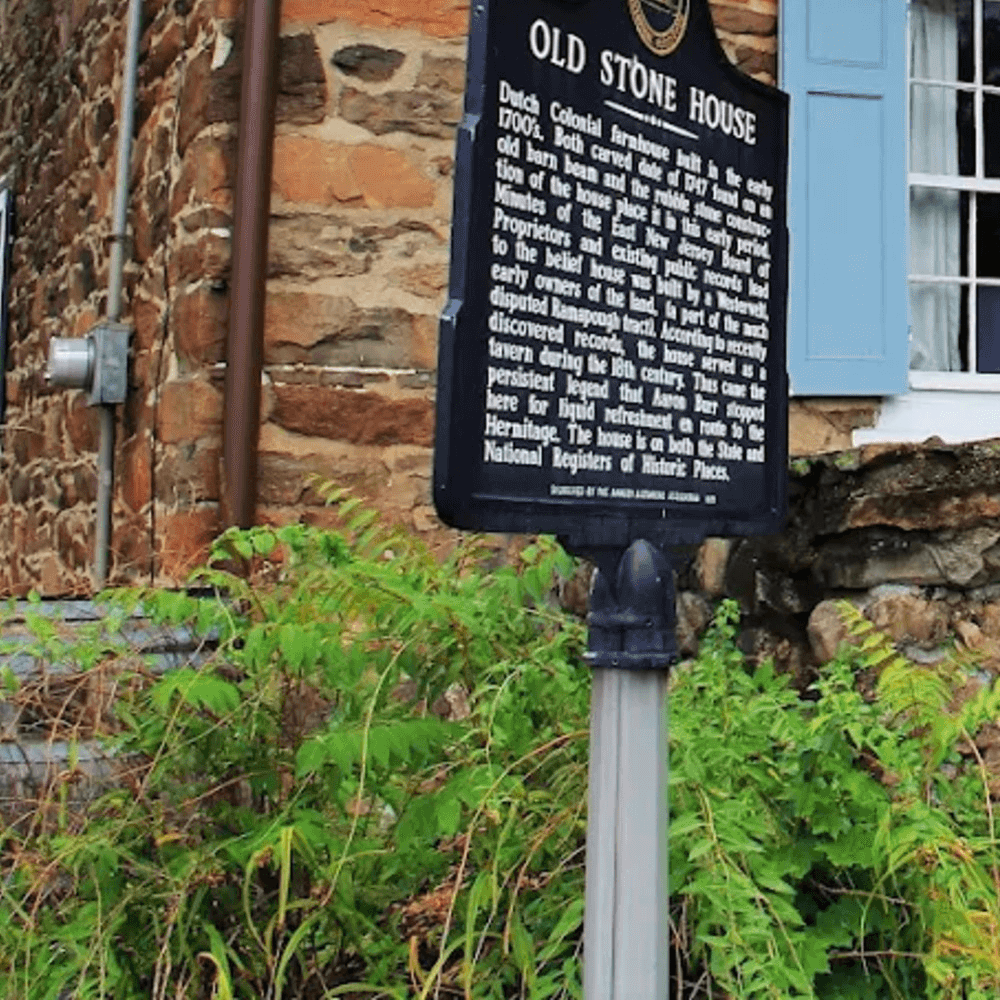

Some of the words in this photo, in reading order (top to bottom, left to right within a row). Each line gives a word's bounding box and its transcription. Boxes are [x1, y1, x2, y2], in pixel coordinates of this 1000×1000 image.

[529, 19, 586, 73] OLD
[600, 49, 678, 112] STONE
[689, 86, 757, 145] HOUSE
[496, 134, 520, 159] old
[525, 140, 558, 171] barn
[563, 153, 599, 185] beam
[602, 172, 626, 194] and
[630, 177, 651, 200] the
[653, 188, 690, 214] rubble
[693, 200, 723, 224] stone
[499, 80, 540, 116] Dutch
[549, 101, 602, 139] Colonial
[610, 123, 670, 163] farmhouse
[675, 148, 702, 174] built
[707, 159, 719, 180] in
[725, 166, 743, 189] the
[746, 178, 774, 202] early
[553, 124, 585, 155] Both
[590, 143, 633, 172] carved
[637, 156, 664, 182] date
[666, 168, 681, 188] of
[711, 182, 739, 209] found
[741, 198, 757, 214] on
[759, 203, 773, 220] an
[494, 181, 547, 216] Minutes
[556, 202, 573, 224] of
[581, 208, 602, 233] the
[611, 215, 637, 242] East
[645, 226, 670, 251] New
[677, 236, 715, 267] Jersey
[721, 249, 752, 275] Board
[757, 261, 771, 280] of
[495, 157, 525, 185] tion
[528, 170, 545, 191] of
[549, 174, 572, 199] the
[575, 181, 613, 212] house
[614, 196, 648, 222] place
[651, 204, 662, 227] it
[664, 210, 677, 231] in
[680, 215, 701, 238] this
[704, 227, 734, 255] early
[491, 233, 509, 256] to
[514, 238, 538, 264] the
[544, 246, 584, 275] belief
[589, 257, 626, 286] house
[629, 273, 652, 291] was
[655, 274, 683, 299] built
[686, 282, 701, 307] by
[703, 291, 713, 307] a
[492, 206, 572, 248] Proprietors
[579, 236, 603, 257] and
[611, 243, 659, 276] existing
[664, 258, 698, 281] public
[703, 269, 743, 293] records
[748, 277, 770, 300] lead
[489, 285, 549, 317] disputed
[659, 321, 715, 355] According
[714, 333, 726, 352] to
[490, 263, 529, 290] early
[534, 273, 582, 299] owners
[587, 283, 602, 303] of
[605, 286, 626, 309] the
[680, 307, 705, 326] part
[707, 311, 721, 330] of
[723, 314, 741, 335] the
[742, 322, 769, 341] much
[488, 310, 565, 345] discovered
[636, 339, 657, 361] the
[662, 343, 696, 368] house
[700, 355, 737, 376] served
[741, 363, 754, 379] as
[759, 366, 767, 381] a
[488, 336, 534, 364] tavern
[538, 345, 584, 377] during
[587, 353, 608, 375] the
[610, 357, 637, 381] 18th
[693, 371, 719, 394] Thus
[720, 380, 748, 399] came
[749, 382, 767, 401] the
[486, 365, 556, 392] persistent
[565, 374, 610, 406] legend
[618, 382, 644, 405] that
[651, 387, 687, 411] Aaron
[693, 393, 719, 416] Burr
[726, 400, 765, 425] stopped
[486, 388, 519, 412] here
[527, 393, 550, 416] for
[558, 397, 596, 429] liquid
[603, 405, 674, 431] refreshment
[699, 419, 728, 438] route
[730, 421, 744, 440] to
[748, 423, 765, 443] the
[483, 440, 543, 467] National
[552, 446, 613, 476] Registers
[620, 453, 636, 474] of
[641, 454, 688, 478] Historic
[568, 423, 593, 445] The
[596, 426, 633, 450] house
[635, 430, 648, 451] is
[649, 437, 664, 453] on
[667, 434, 695, 456] both
[697, 439, 715, 459] the
[716, 439, 744, 461] State
[746, 444, 765, 463] and
